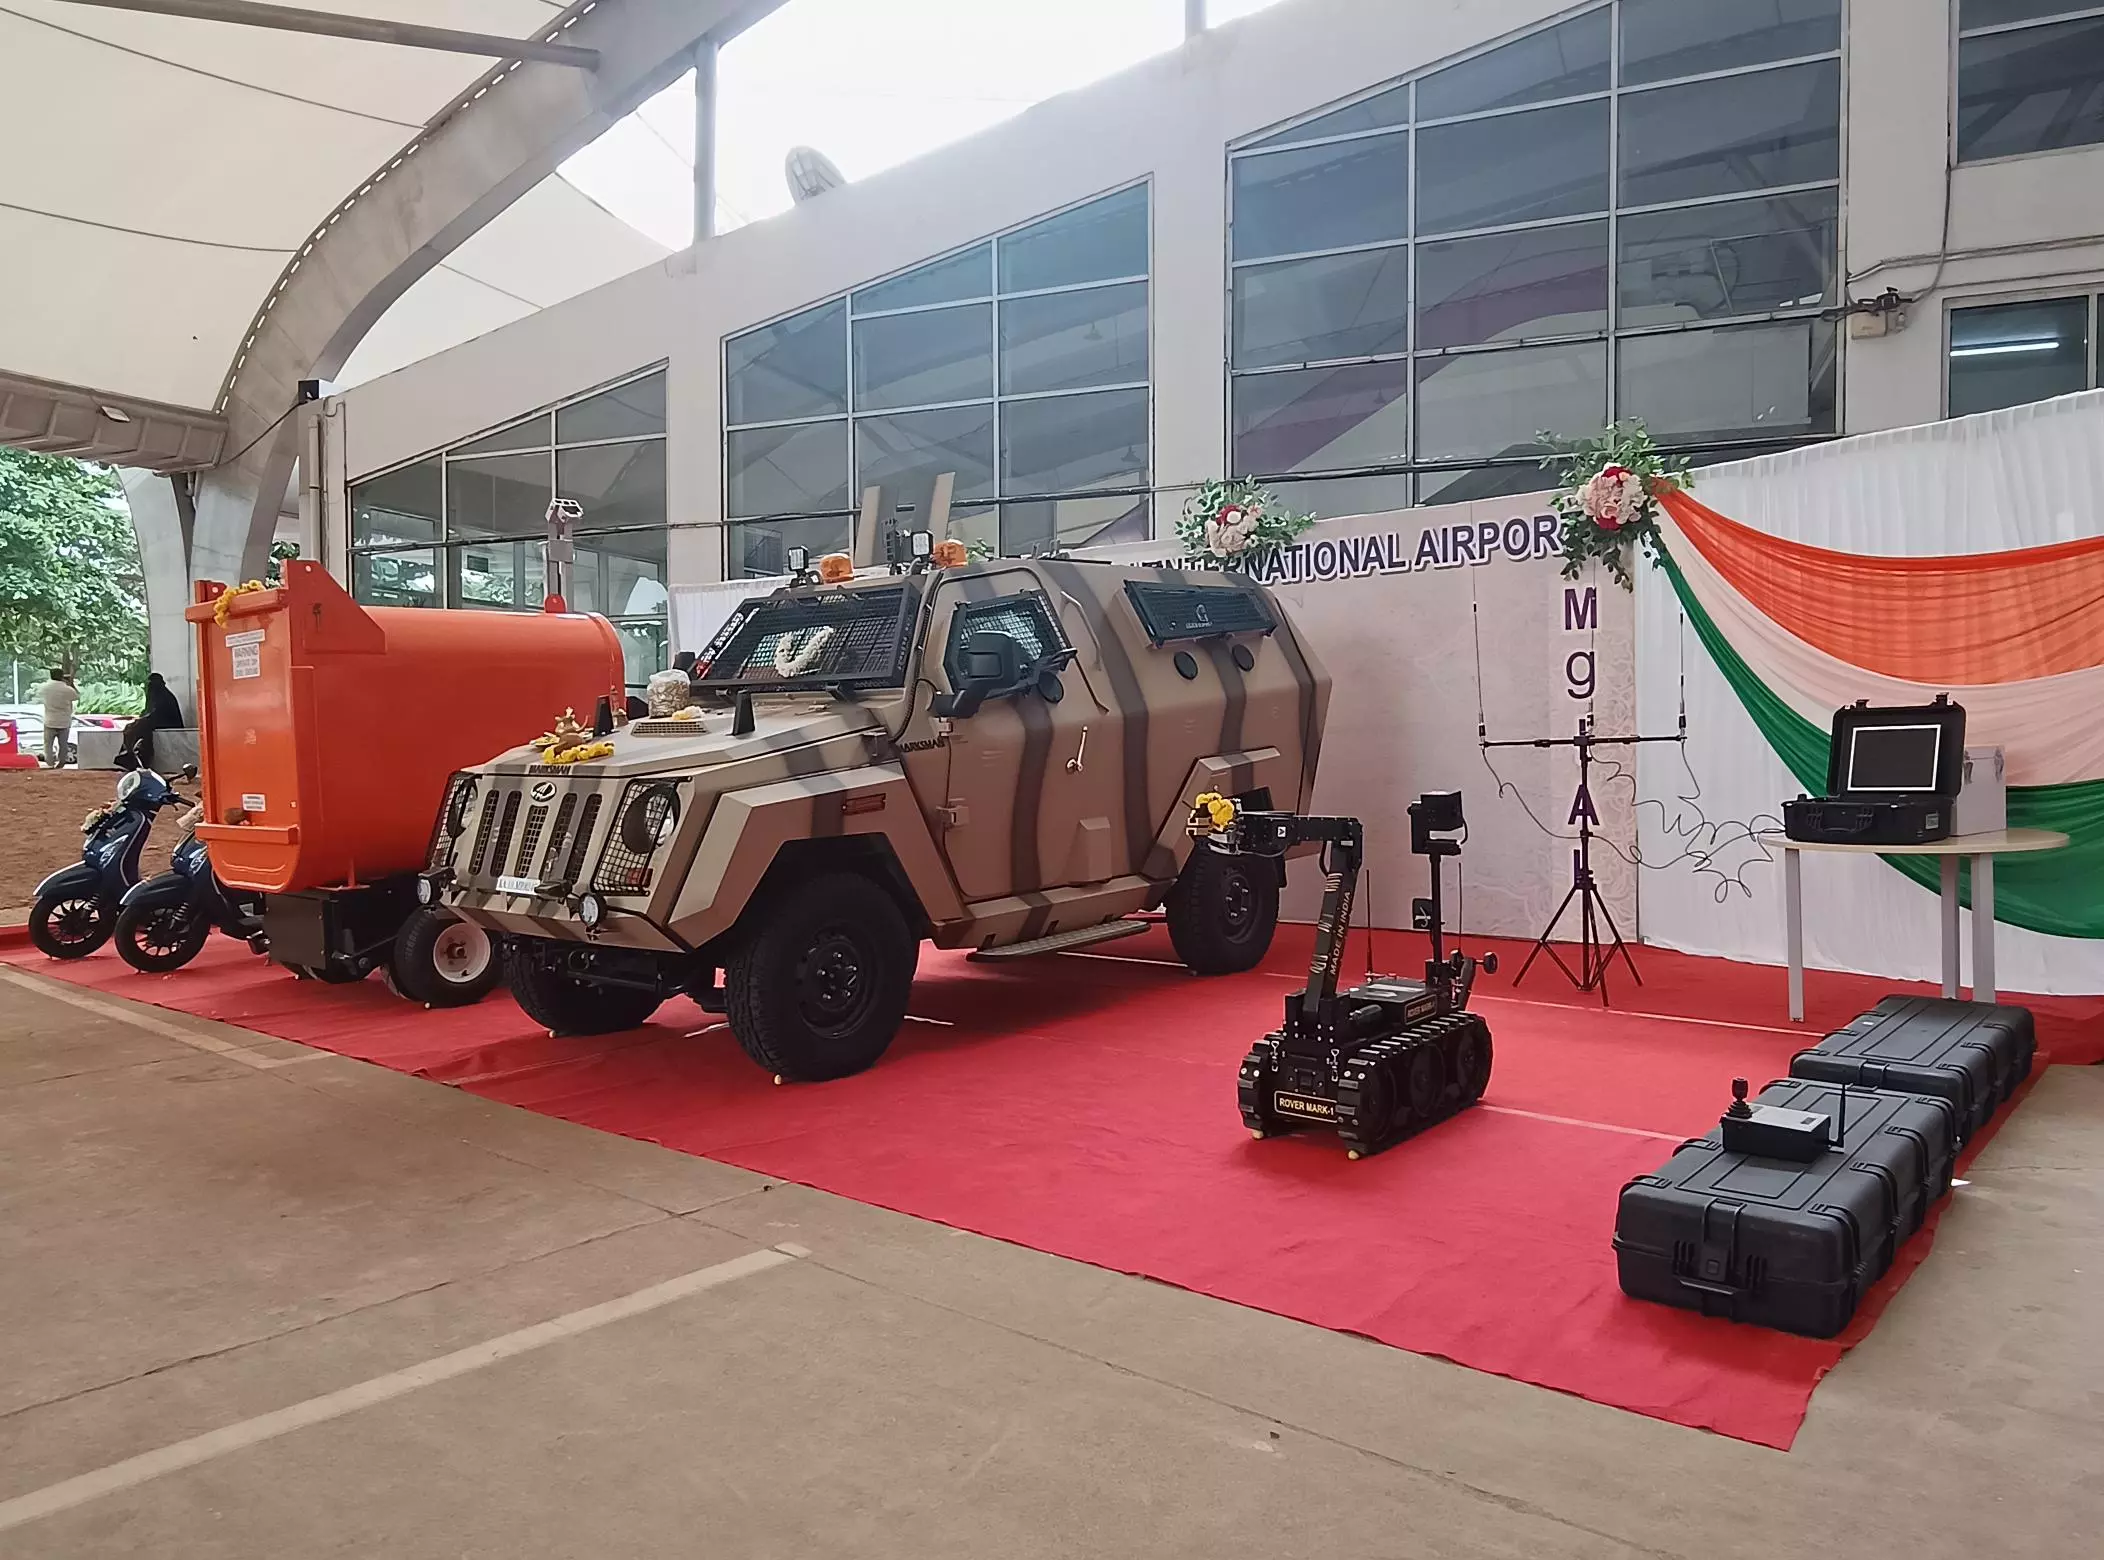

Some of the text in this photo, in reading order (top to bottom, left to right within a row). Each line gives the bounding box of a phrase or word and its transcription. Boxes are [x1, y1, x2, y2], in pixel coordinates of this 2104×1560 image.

[1414, 511, 1584, 567] AIRPOR
[1329, 892, 1351, 976] MADE IN INDIA
[1279, 1098, 1334, 1116] ROVER MARK-1
